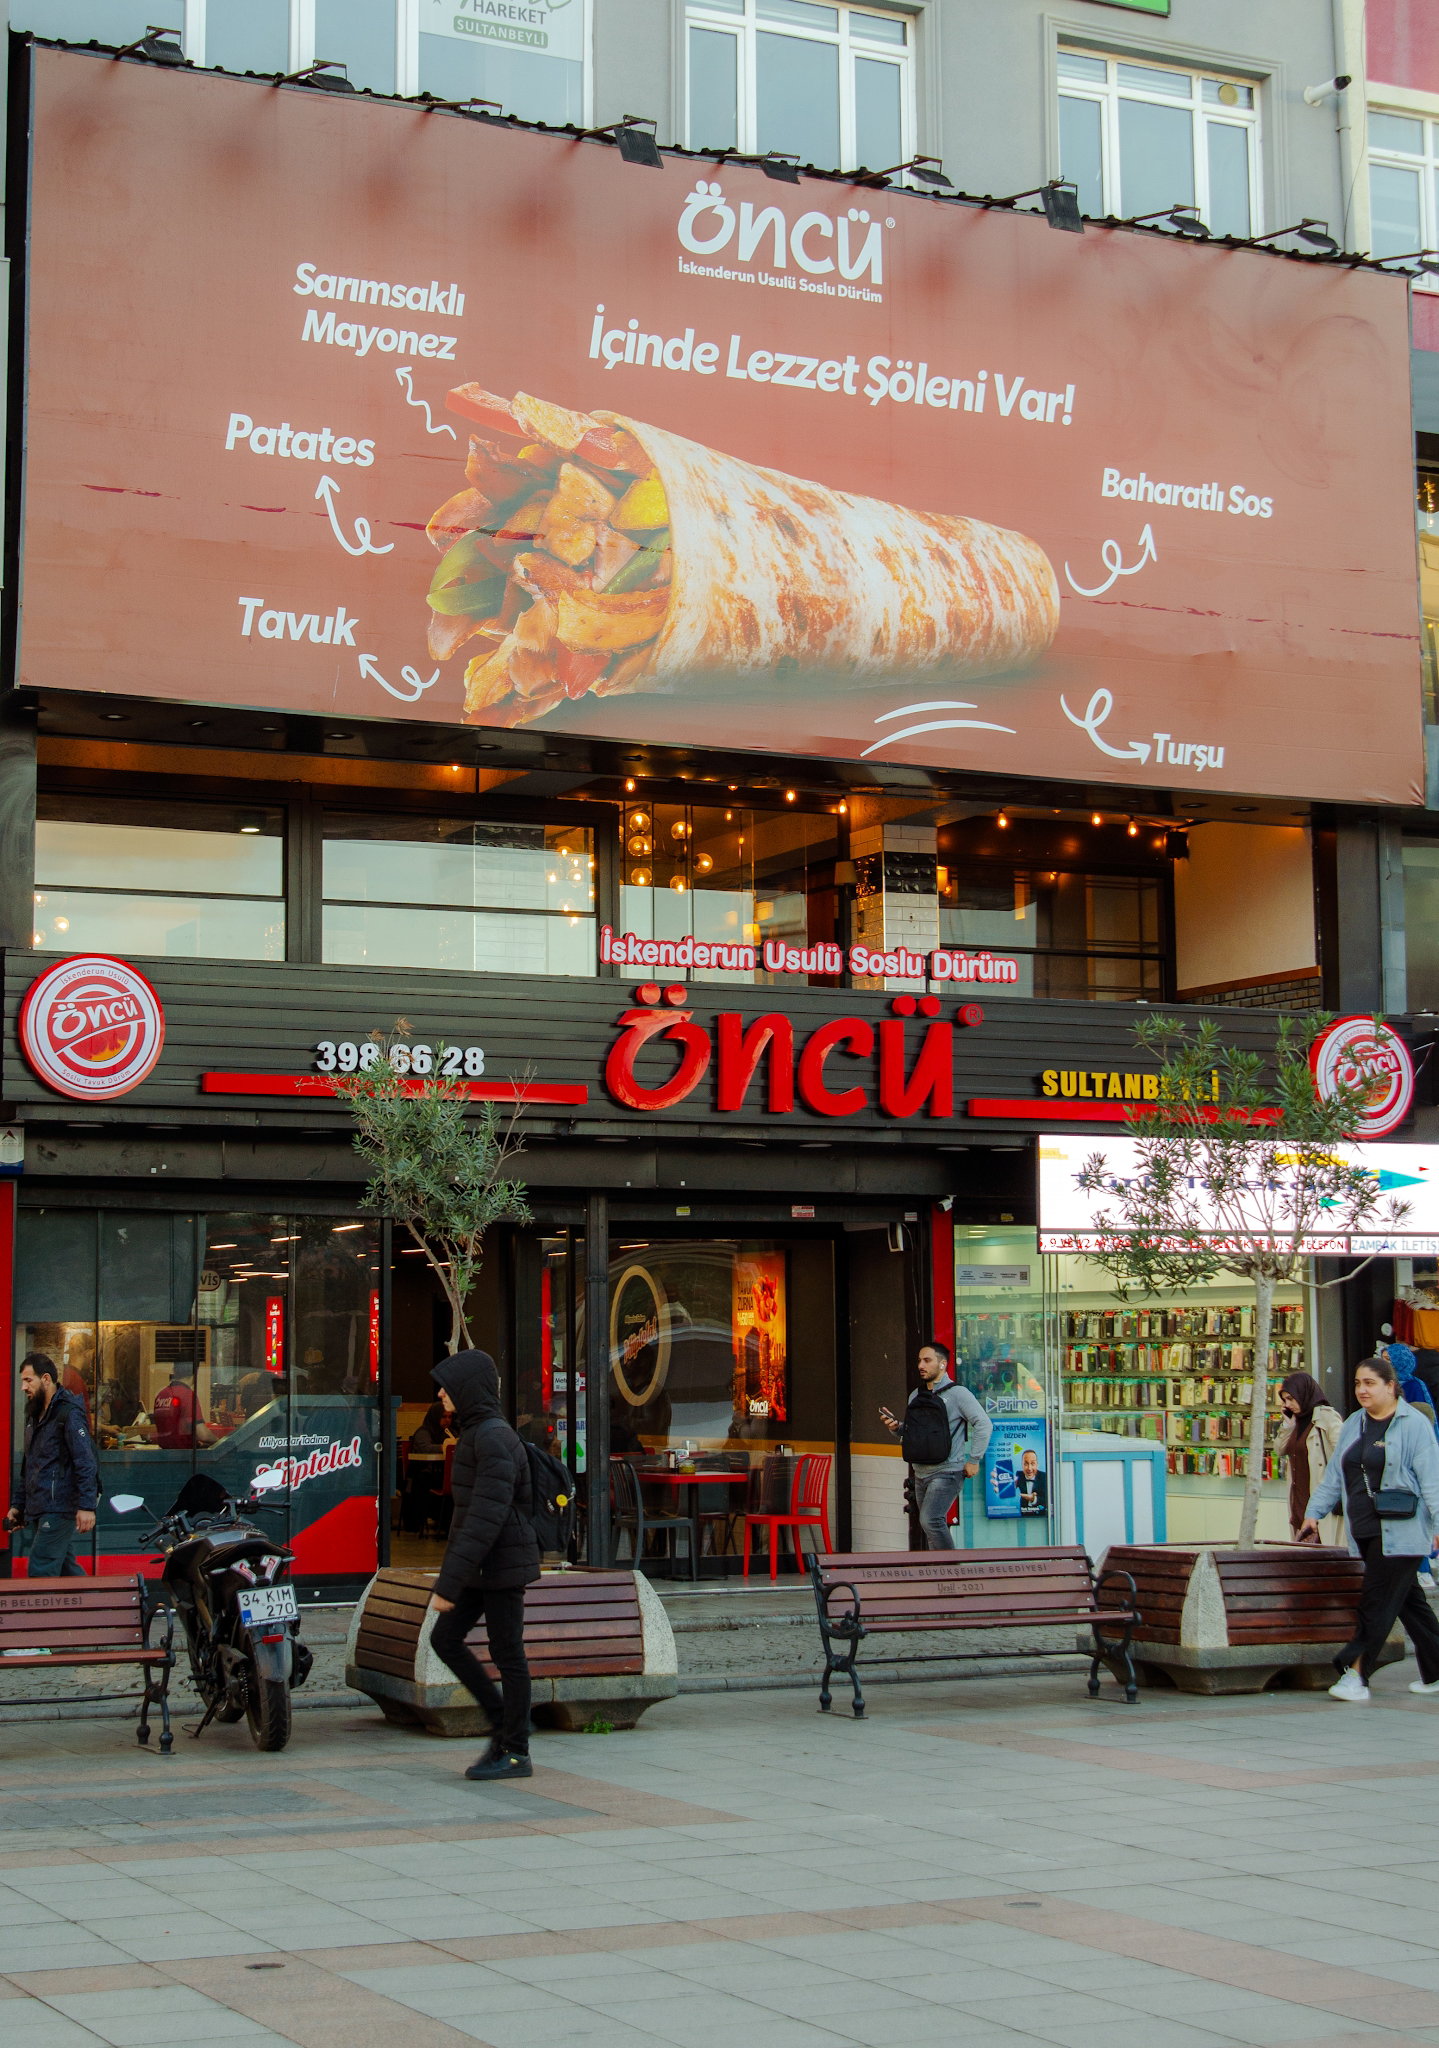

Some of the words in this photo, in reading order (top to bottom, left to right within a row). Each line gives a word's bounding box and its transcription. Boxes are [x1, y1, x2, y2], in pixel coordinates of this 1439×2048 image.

[473, 0, 547, 25] HAREKET
[456, 18, 546, 47] SULTANBEYLİ
[293, 262, 466, 317] Sarımsaklı
[677, 256, 756, 284] İskenderun
[757, 271, 797, 290] Usulü
[798, 278, 836, 297] Soslu
[837, 284, 883, 304] Dürüm
[301, 309, 458, 361] Mayonez
[588, 304, 720, 375] İçinde
[726, 335, 860, 395] Lezzet
[863, 355, 987, 414] Şöleni
[994, 373, 1076, 426] Var!
[225, 412, 376, 467] Patates
[1101, 467, 1224, 512] Baharatlı
[1227, 485, 1274, 518] Sos
[238, 596, 360, 647] Tavuk
[1152, 732, 1224, 772] Turşu
[601, 925, 756, 971] İskenderun
[763, 939, 842, 974] Usulü
[849, 946, 925, 978] Soslu
[931, 950, 1018, 983] Dürüm
[61, 968, 105, 985] İskenderun
[316, 1041, 380, 1071] 398
[389, 1043, 433, 1074] 66
[442, 1046, 485, 1076] 28
[61, 1069, 81, 1083] Soslu
[84, 1078, 106, 1086] Tavuk
[1352, 1239, 1397, 1251] ZAMBAK
[1402, 1238, 1439, 1254] İLETİŞ
[997, 1399, 1039, 1412] prime
[242, 1592, 260, 1606] 34
[266, 1588, 292, 1603] KIM
[266, 1602, 294, 1617] 270
